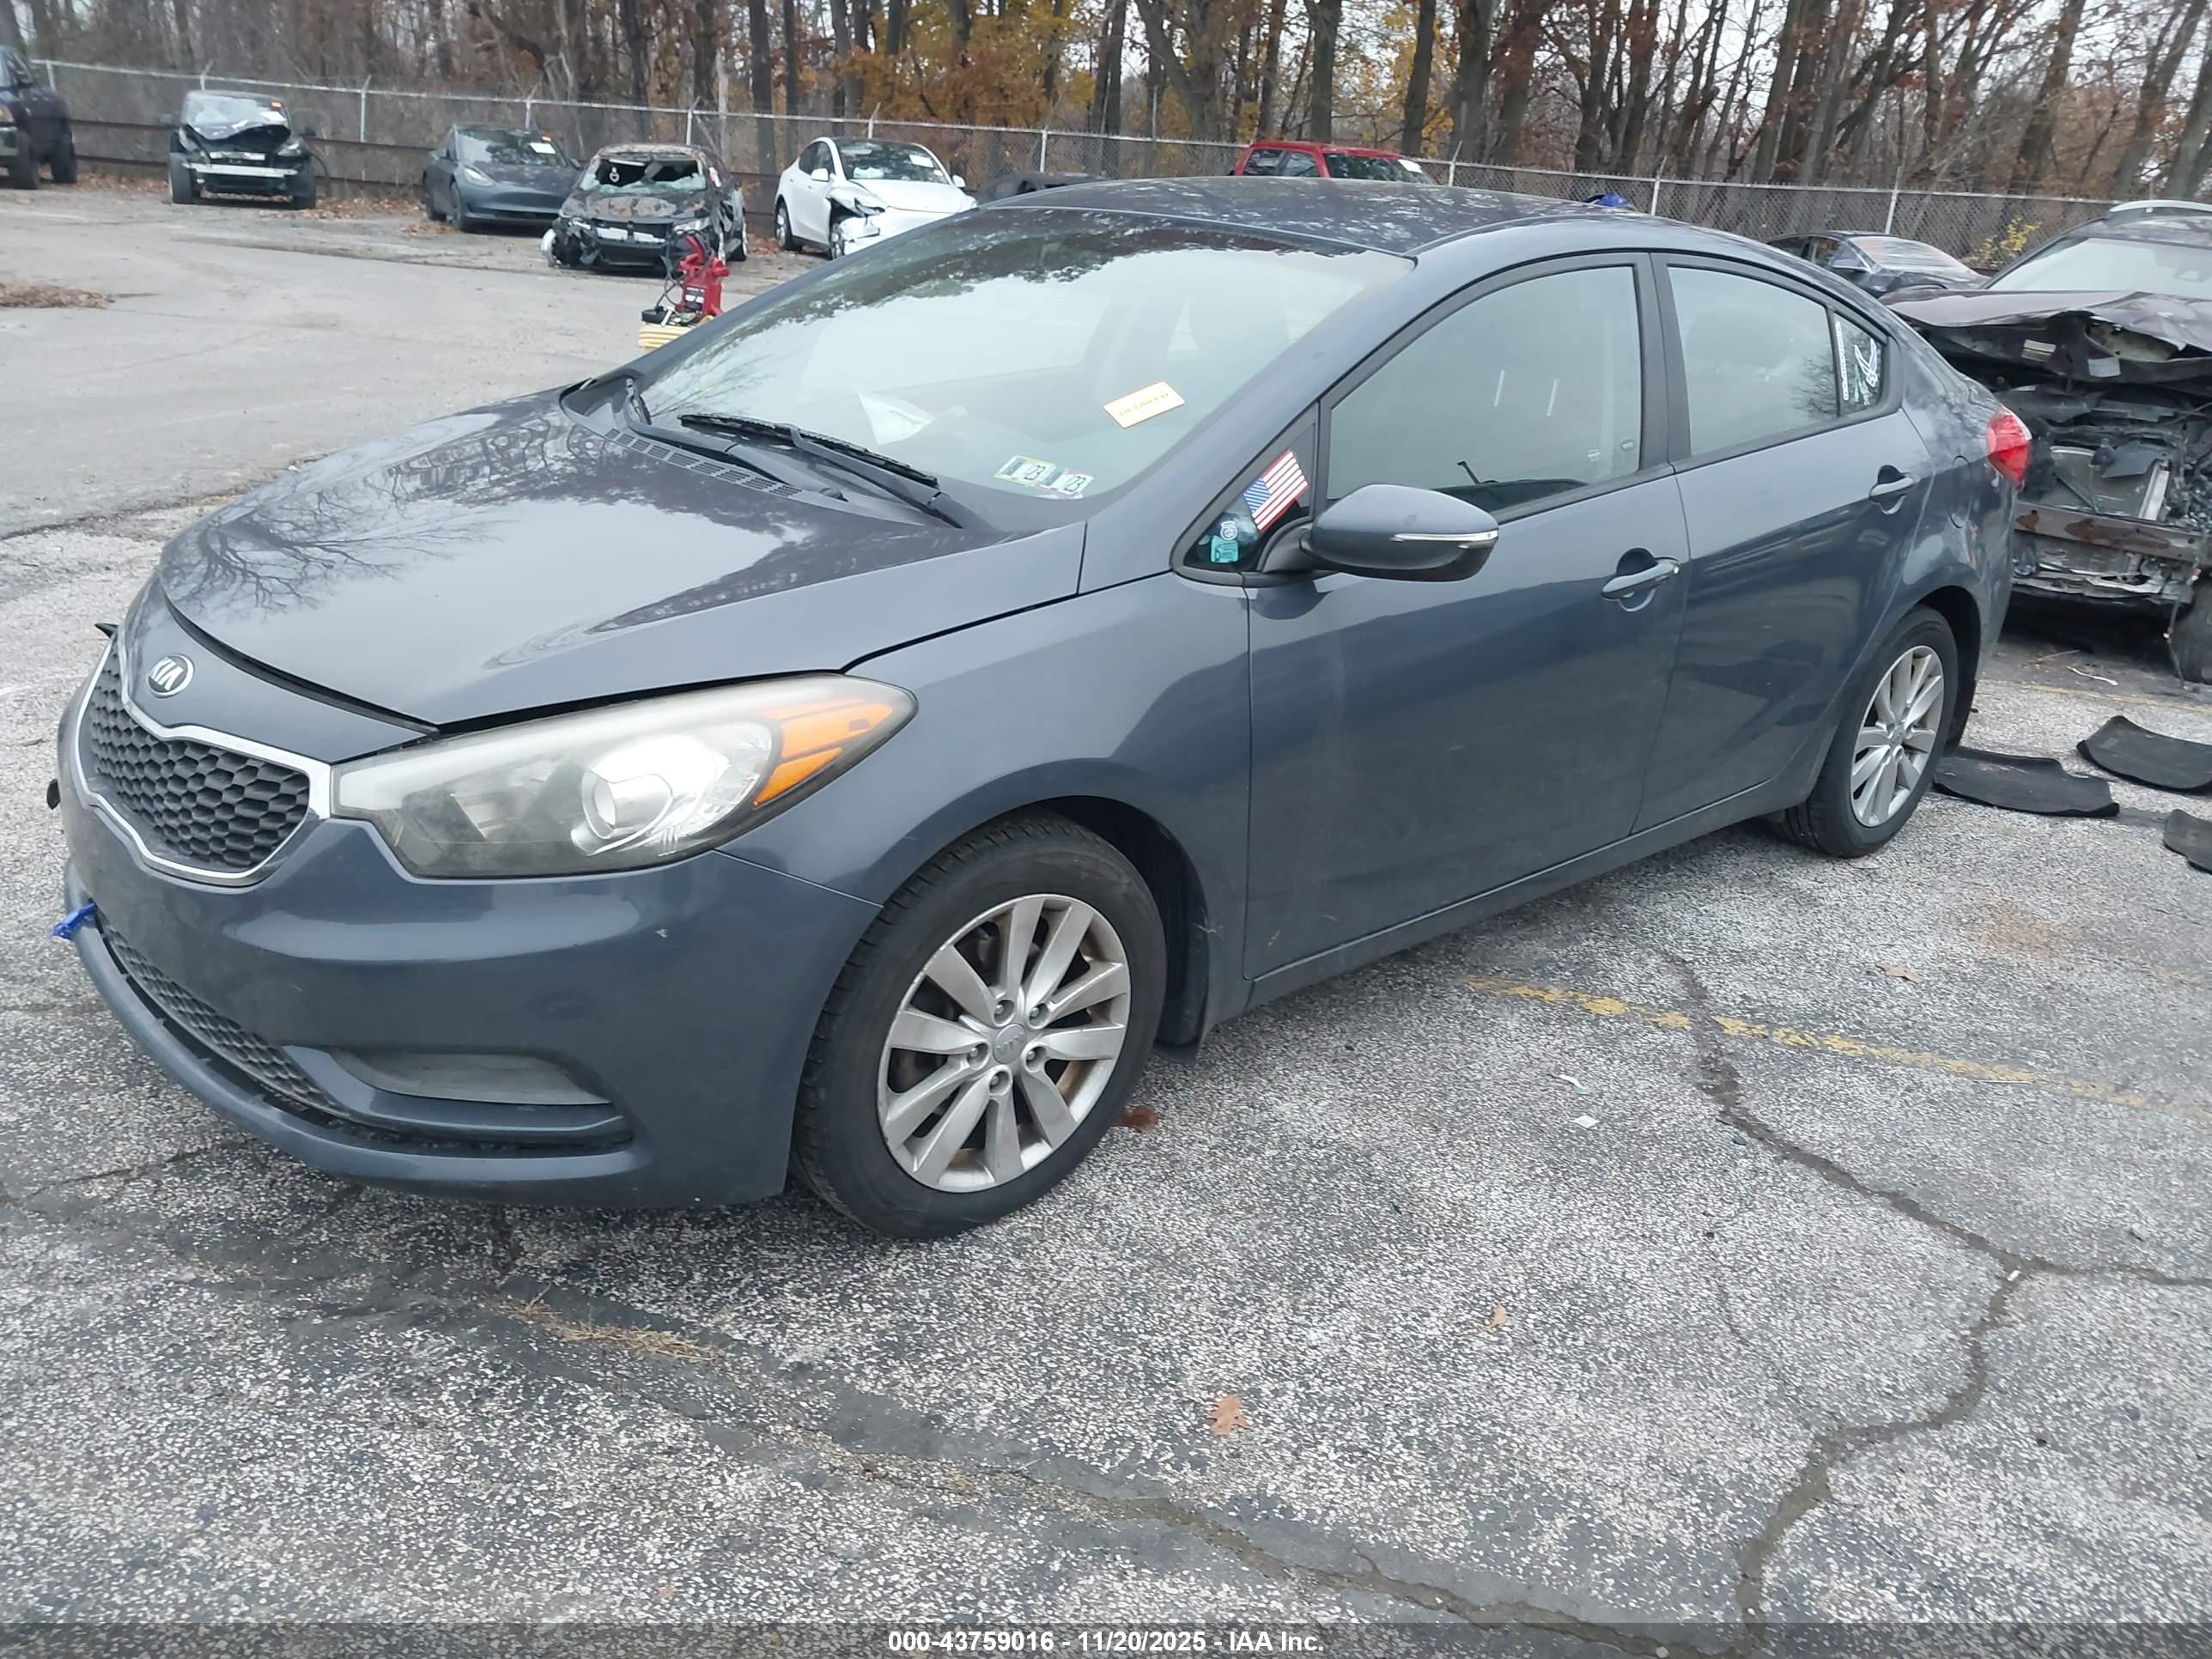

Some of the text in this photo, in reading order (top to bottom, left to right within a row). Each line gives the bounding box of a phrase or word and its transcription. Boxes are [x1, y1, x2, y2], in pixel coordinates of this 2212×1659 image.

[1024, 464, 1046, 481] 23
[1064, 476, 1086, 493] 23
[149, 656, 185, 691] KIA
